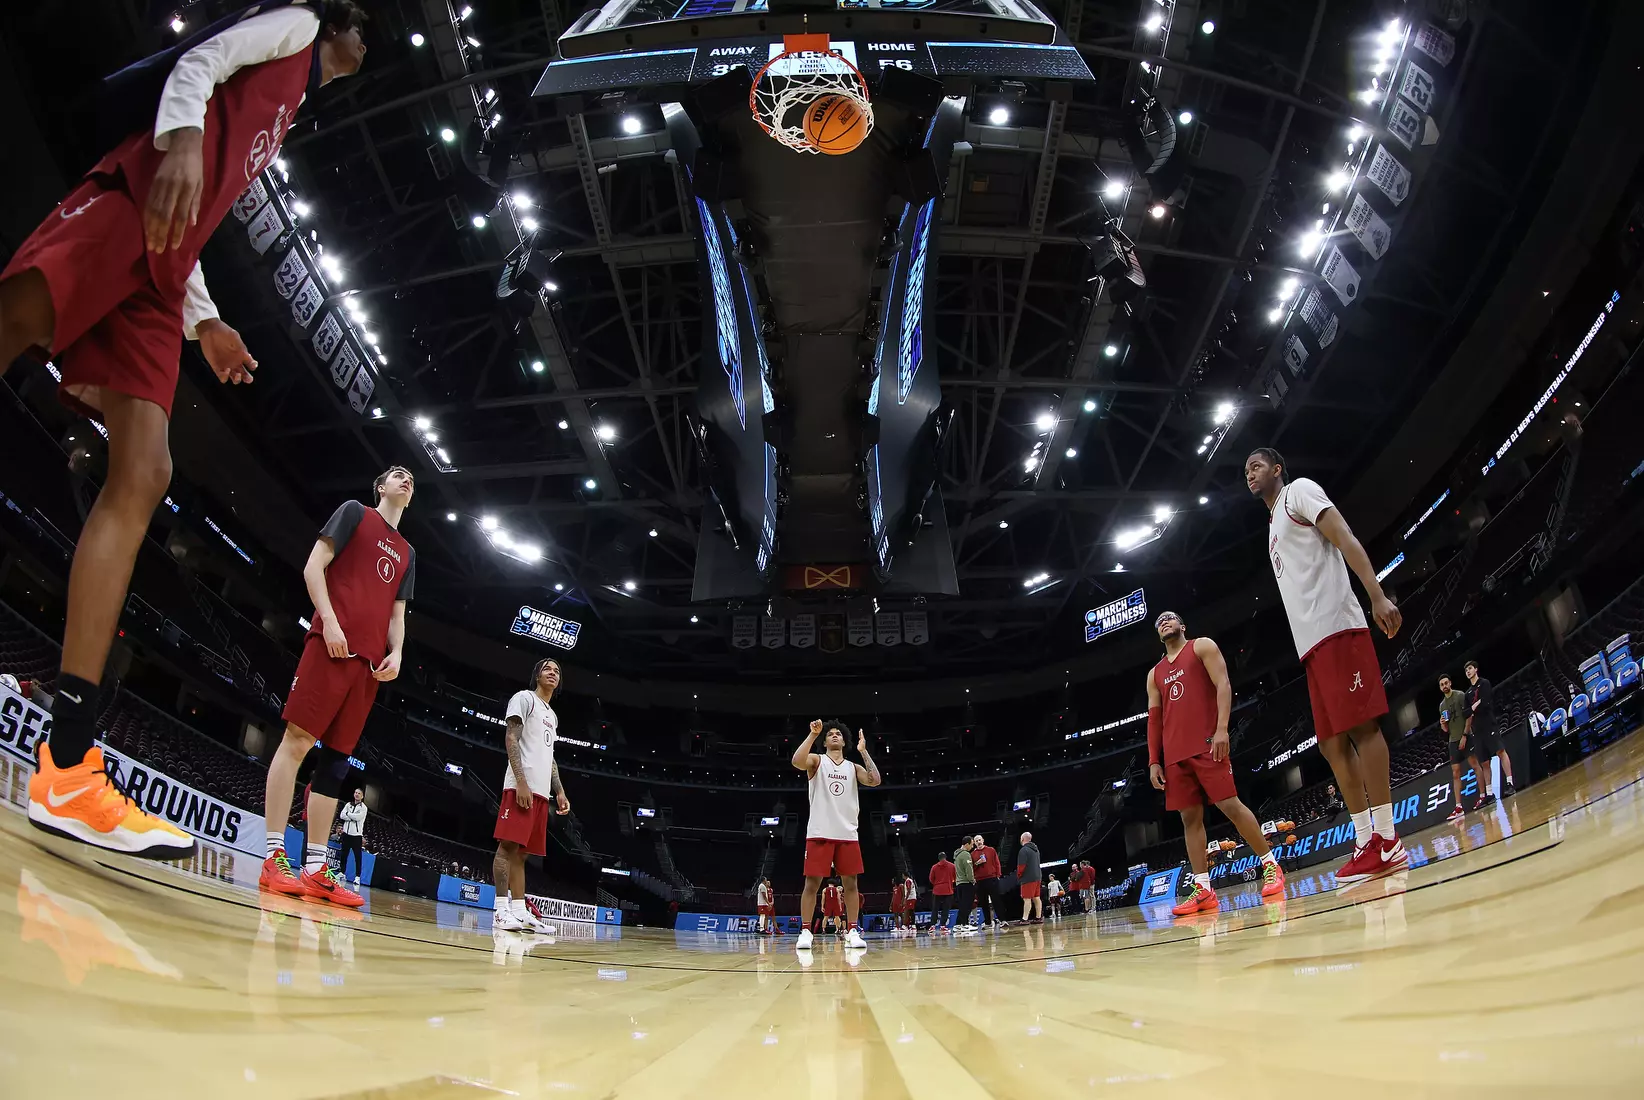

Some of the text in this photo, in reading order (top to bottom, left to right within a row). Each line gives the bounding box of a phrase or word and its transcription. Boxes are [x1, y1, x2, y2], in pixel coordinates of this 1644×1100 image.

[709, 46, 756, 57] AWAY
[867, 43, 916, 51] HOME
[878, 59, 913, 71] 56
[1410, 71, 1432, 106] 27
[1396, 110, 1418, 143] 15
[237, 187, 257, 218] 42
[255, 222, 271, 240] 7
[265, 212, 278, 231] SMITH
[277, 262, 298, 294] 22
[294, 292, 315, 321] 25
[317, 327, 335, 355] 43
[1290, 348, 1302, 366] 9
[334, 357, 351, 382] 11
[1496, 438, 1512, 460] 2025
[1517, 410, 1536, 434] MEN'S
[1533, 370, 1568, 414] BASKETBALL
[1564, 312, 1607, 372] CHAMPIONSHIP
[376, 539, 401, 564] ALABAMA
[383, 562, 390, 577] 4
[529, 610, 564, 631] MARCH
[1095, 598, 1128, 621] MARCH
[1101, 602, 1145, 630] MADNESS
[530, 622, 576, 647] MADNESS
[1163, 668, 1185, 685] ALABAMA
[1172, 685, 1179, 697] 8
[1119, 711, 1150, 725] BASKETBAL
[1273, 736, 1318, 768] FIRST SECON
[827, 772, 848, 781] ALABAMA
[834, 784, 840, 793] 2
[125, 765, 242, 845] ROUNDS
[1314, 820, 1358, 852] FINA
[562, 903, 596, 921] CONFERENCE
